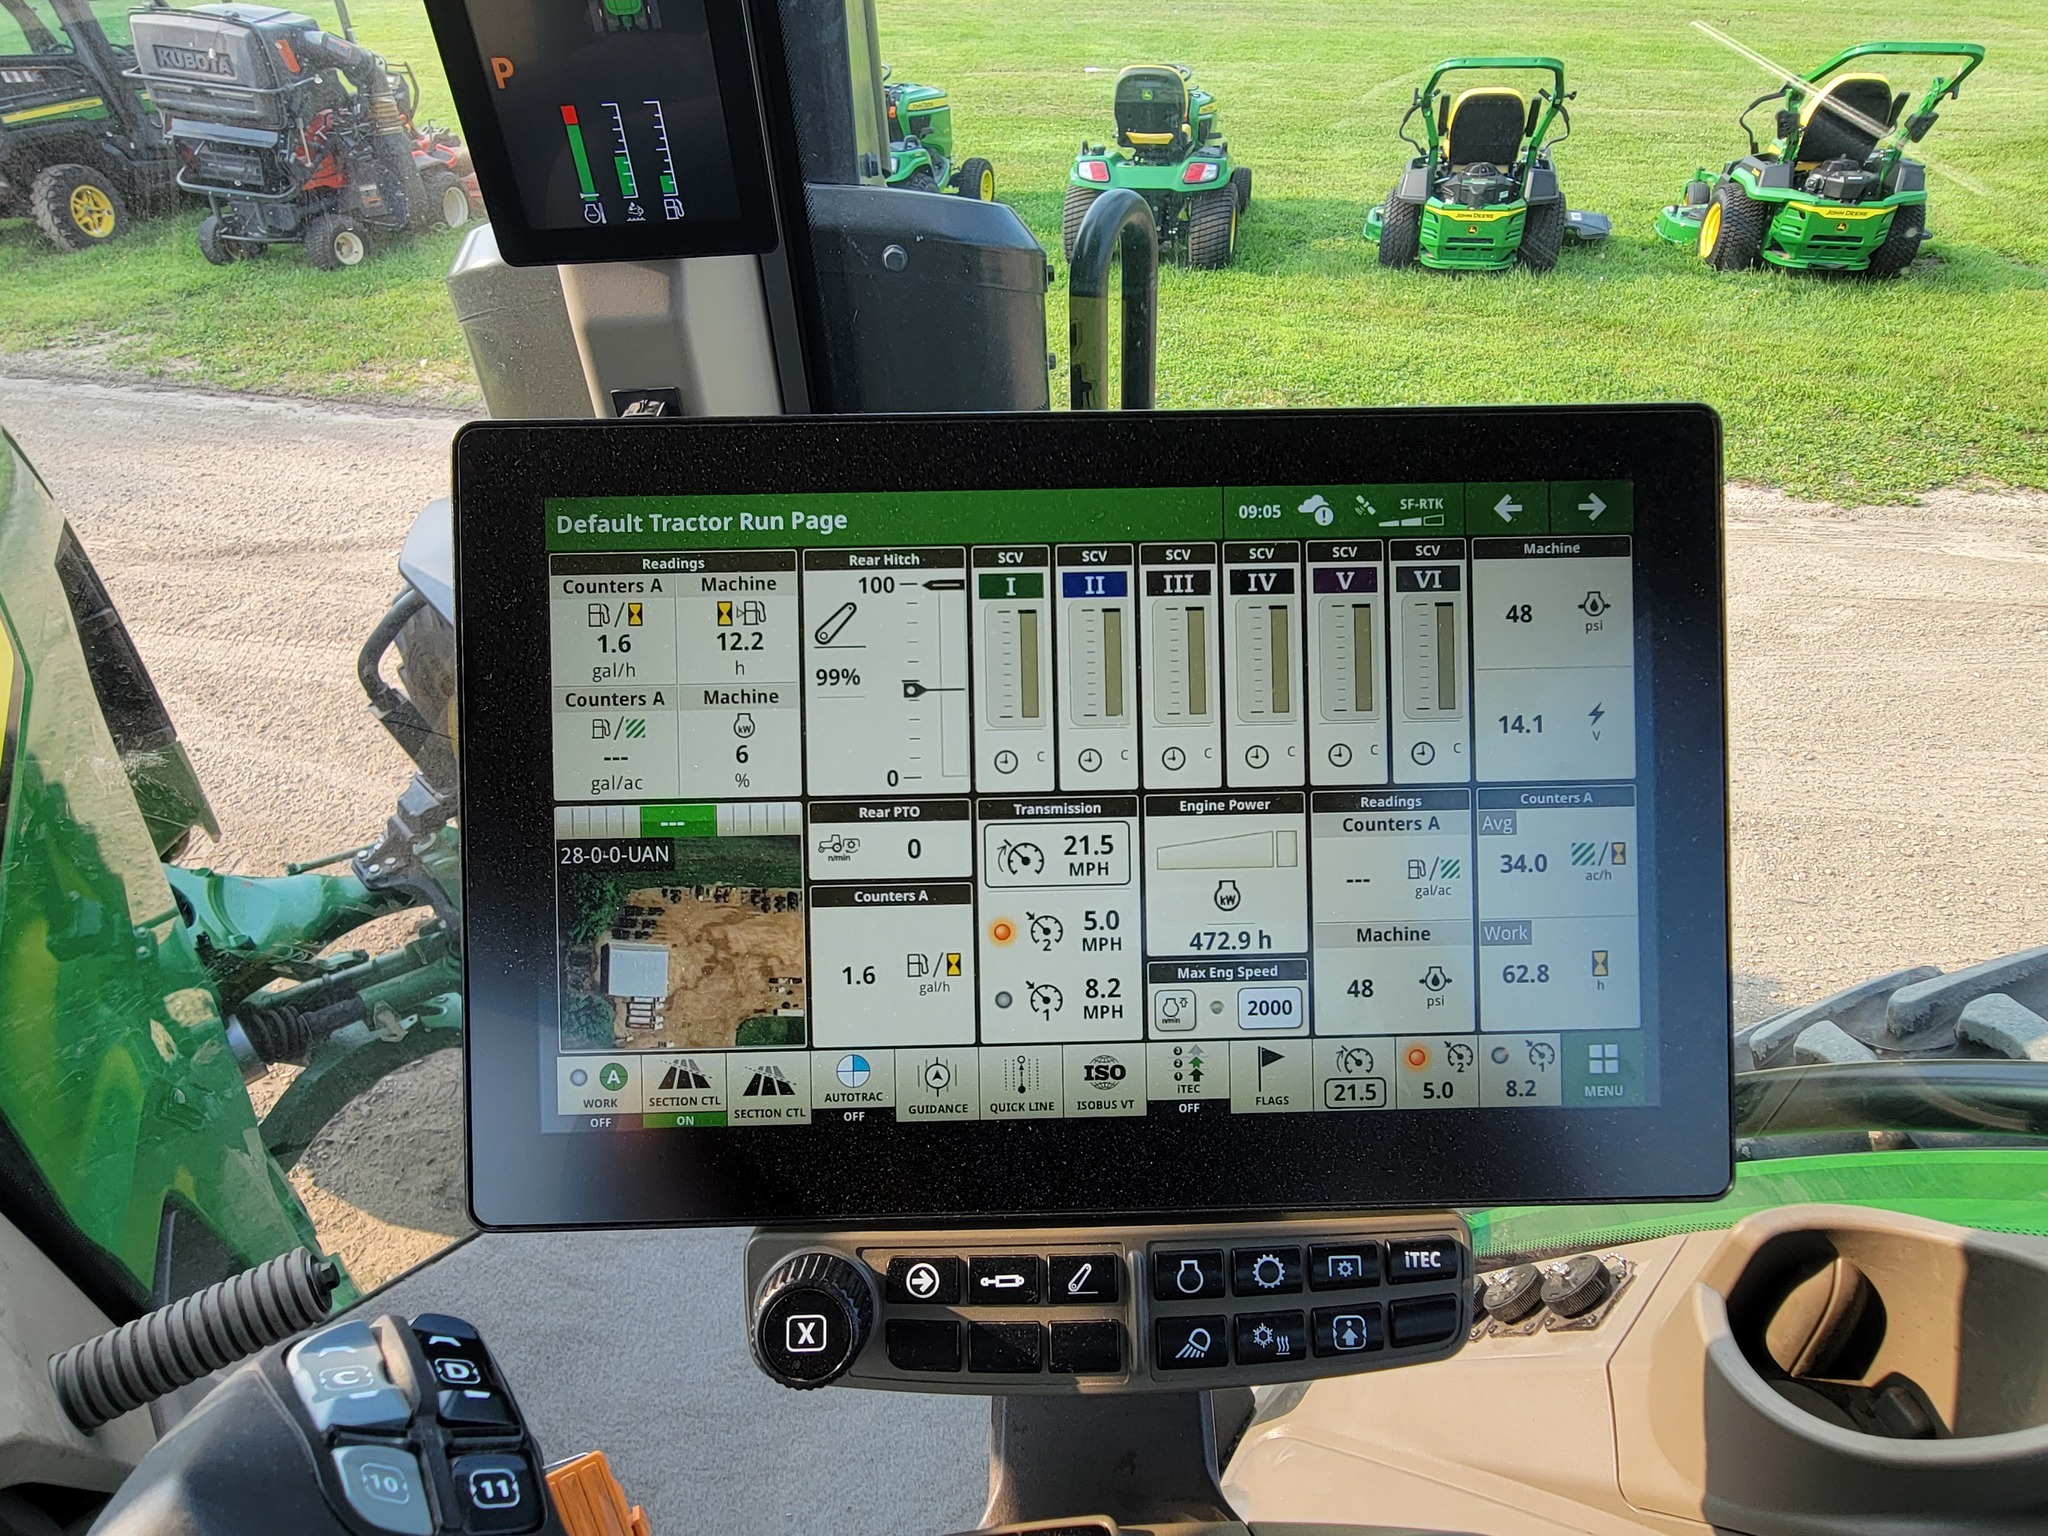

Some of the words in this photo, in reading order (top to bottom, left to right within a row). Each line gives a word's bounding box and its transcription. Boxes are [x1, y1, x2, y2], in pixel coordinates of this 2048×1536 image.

[157, 48, 234, 75] KUBOTA
[490, 57, 514, 89] P
[1400, 498, 1444, 510] SF-RTK
[1239, 505, 1282, 518] 09:05
[557, 513, 643, 533] Default
[649, 513, 733, 533] Tractor
[740, 512, 784, 531] Run
[792, 512, 847, 534] Page
[1165, 549, 1191, 561] SCV
[1249, 548, 1274, 559] SCV
[1332, 546, 1357, 558] SCV
[1415, 546, 1440, 556] SCV
[1524, 543, 1580, 554] Machine
[850, 555, 880, 566] Rear
[884, 554, 920, 565] Hitch
[998, 552, 1023, 563] SCV
[1082, 551, 1107, 562] SCV
[642, 558, 705, 571] Readings
[563, 580, 644, 594] Counters
[650, 578, 663, 592] A
[701, 576, 777, 591] Machine
[858, 576, 895, 594] 100
[1085, 576, 1105, 594] II
[1163, 574, 1194, 593] III
[1248, 573, 1277, 591] IV
[1336, 572, 1355, 590] V
[1414, 570, 1442, 588] VI
[1506, 604, 1533, 623] 48
[1585, 620, 1603, 634] psi
[597, 634, 631, 653] 1.6
[716, 632, 764, 650] 12.2
[592, 662, 636, 682] gal/h
[735, 660, 745, 675] h
[816, 668, 860, 686] 99%
[565, 693, 646, 707] Counters
[652, 691, 665, 705] A
[704, 689, 779, 704] Machine
[738, 725, 751, 733] kW
[1499, 715, 1543, 734] 14.1
[736, 745, 748, 763] 6
[591, 775, 643, 794] gal/ac
[735, 773, 750, 787] %
[887, 770, 898, 787] 0
[1361, 796, 1422, 810] Readings
[1521, 793, 1580, 804] Counters
[1583, 793, 1593, 803] A
[859, 807, 890, 818] Rear
[894, 807, 920, 817] PTO
[1013, 803, 1101, 815] Transmission
[1180, 801, 1225, 814] Engine
[1229, 800, 1270, 811] Power
[1343, 818, 1422, 832] Counters
[1428, 816, 1440, 830] A
[1482, 817, 1513, 834] Avg
[907, 839, 921, 859] 0
[1064, 835, 1114, 855] 21.5
[561, 846, 669, 864] 28-0-0-UAN
[1069, 862, 1109, 876] MPH
[1500, 854, 1548, 873] 34.0
[1585, 870, 1612, 881] ac/h
[854, 892, 916, 902] Counters
[919, 890, 929, 901] A
[1415, 885, 1452, 899] gal/ac
[1220, 895, 1236, 905] kW
[1084, 910, 1120, 930] 5.0
[1190, 931, 1251, 950] 472.9
[1259, 930, 1272, 949] h
[1357, 928, 1430, 942] Machine
[1484, 926, 1528, 940] Work
[1043, 939, 1051, 951] 2
[1082, 937, 1122, 951] MPH
[842, 966, 875, 985] 1.6
[1178, 968, 1206, 979] Max
[1210, 967, 1234, 980] Eng
[1237, 965, 1278, 980] Speed
[1502, 964, 1550, 984] 62.8
[919, 982, 950, 996] gal/h
[1085, 978, 1121, 998] 8.2
[1347, 979, 1373, 998] 48
[1598, 980, 1604, 990] h
[1248, 1000, 1292, 1016] 2000
[1427, 995, 1444, 1009] psi
[1084, 1005, 1123, 1019] MPH
[607, 1070, 621, 1084] A
[1084, 1064, 1126, 1081] ISO
[1178, 1084, 1201, 1093] iTEC
[1334, 1083, 1377, 1101] 21.5
[1423, 1081, 1454, 1099] 5.0
[1506, 1080, 1536, 1097] 8.2
[1585, 1085, 1623, 1097] MENU
[583, 1099, 618, 1108] WORK
[649, 1097, 697, 1107] SECTION
[701, 1096, 721, 1106] CTL
[825, 1092, 883, 1103] AUTOTRAC
[1256, 1096, 1289, 1106] FLAGS
[909, 1104, 968, 1114] GUIDANCE
[990, 1103, 1025, 1114] QUICK
[1029, 1102, 1055, 1112] LINE
[1077, 1100, 1117, 1110] ISOBUS
[1121, 1100, 1134, 1109] VT
[1179, 1103, 1201, 1113] OFF
[734, 1109, 782, 1119] SECTION
[786, 1108, 806, 1118] CTL
[844, 1112, 865, 1122] OFF
[590, 1118, 612, 1128] OFF
[677, 1116, 694, 1126] ON
[1405, 1251, 1441, 1268] iTEC
[797, 1322, 815, 1344] X
[445, 1362, 469, 1379] D
[333, 1371, 360, 1386] C
[371, 1474, 398, 1492] 10
[481, 1480, 509, 1499] 11
